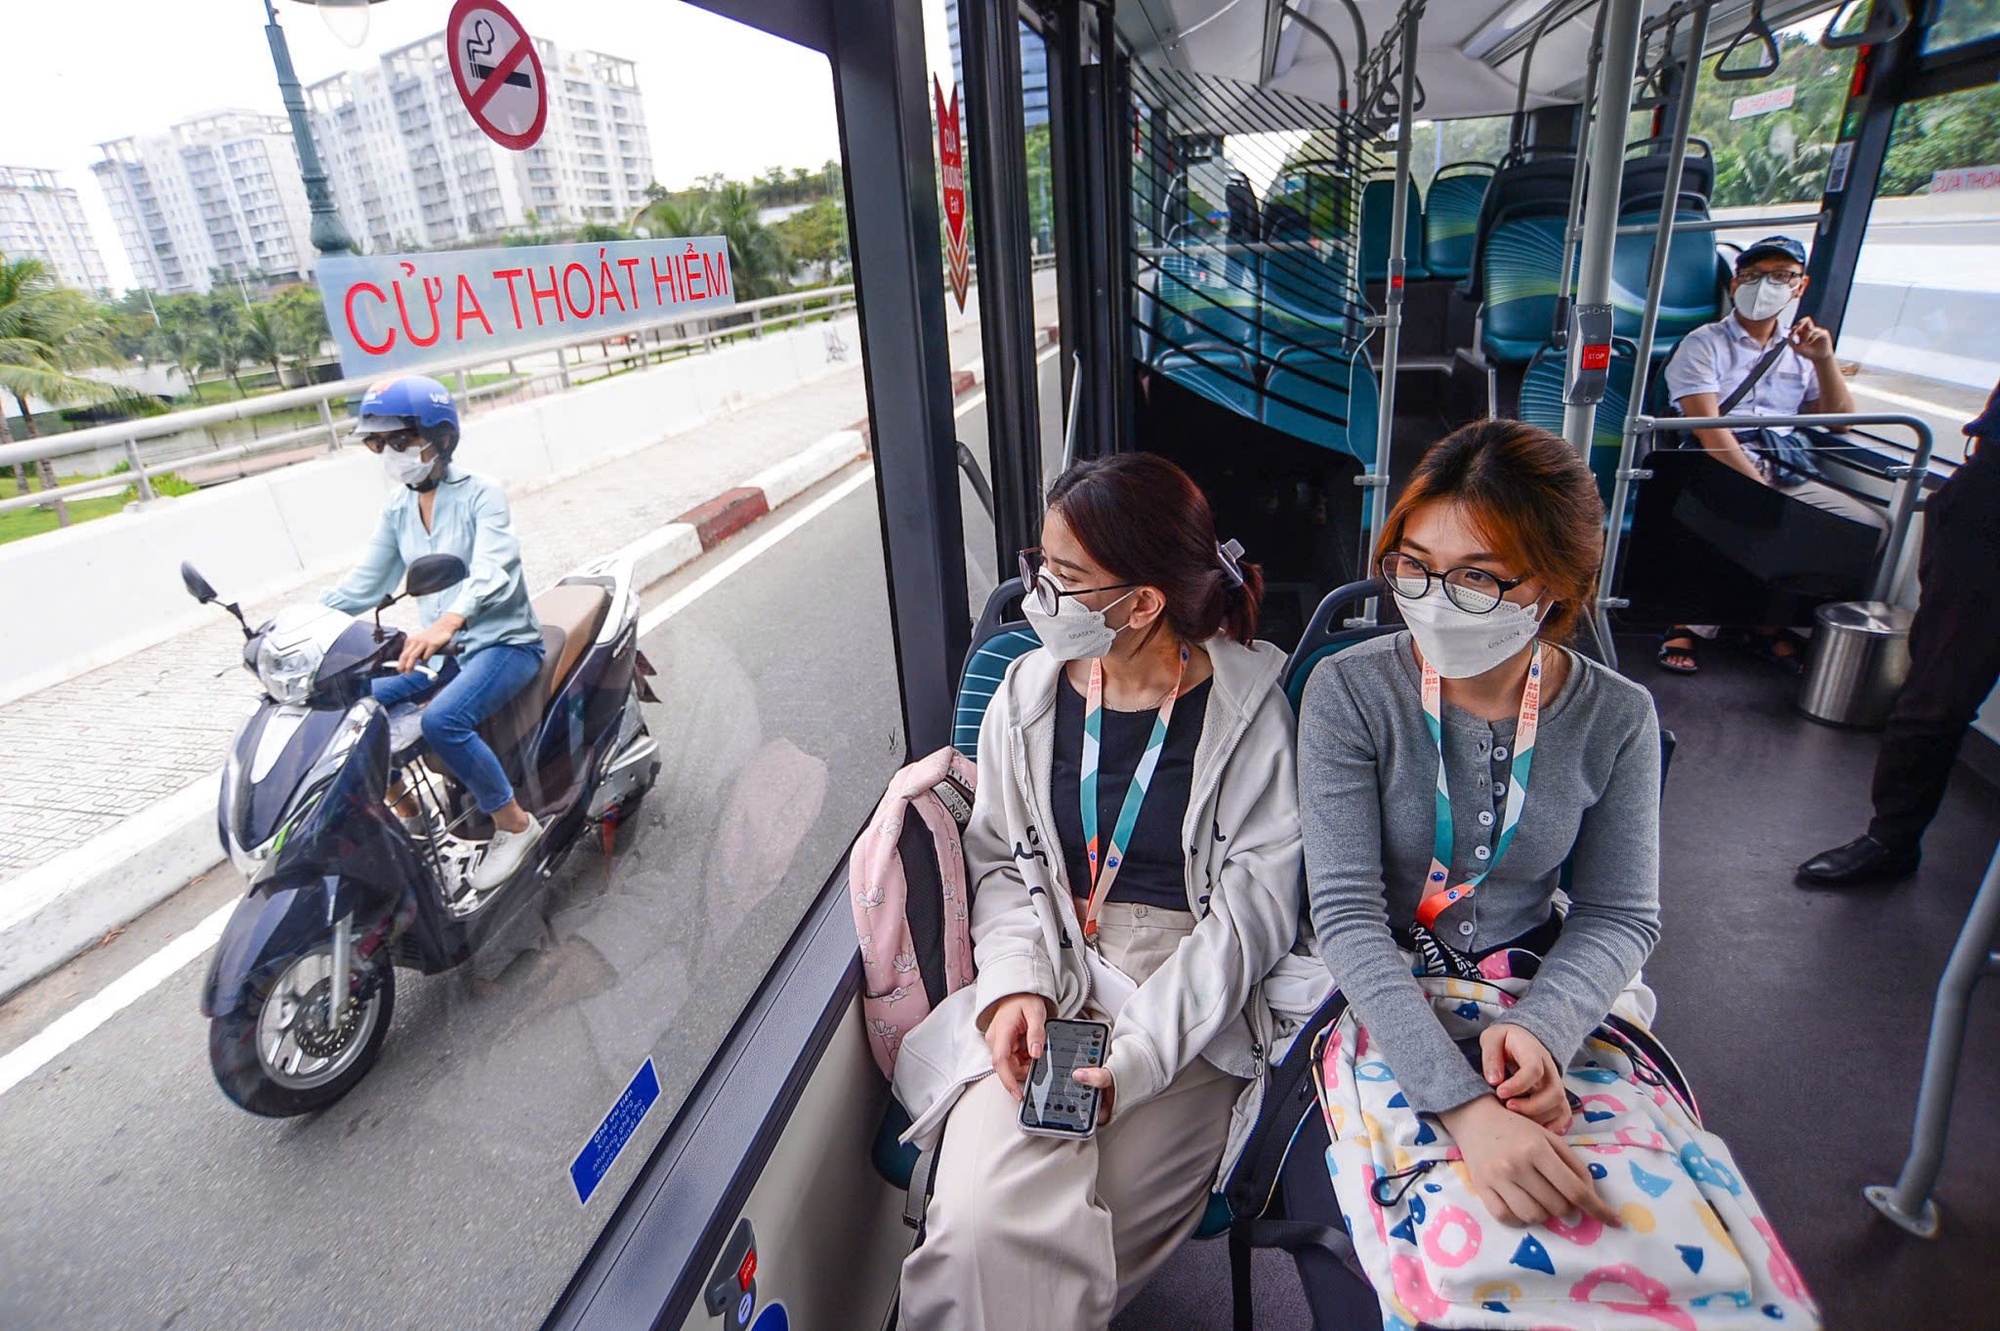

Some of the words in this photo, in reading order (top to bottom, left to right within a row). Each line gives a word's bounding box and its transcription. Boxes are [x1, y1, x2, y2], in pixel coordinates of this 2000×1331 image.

[344, 261, 494, 356] CỬA
[493, 248, 640, 330] THOÁT
[651, 242, 729, 306] HIỂM
